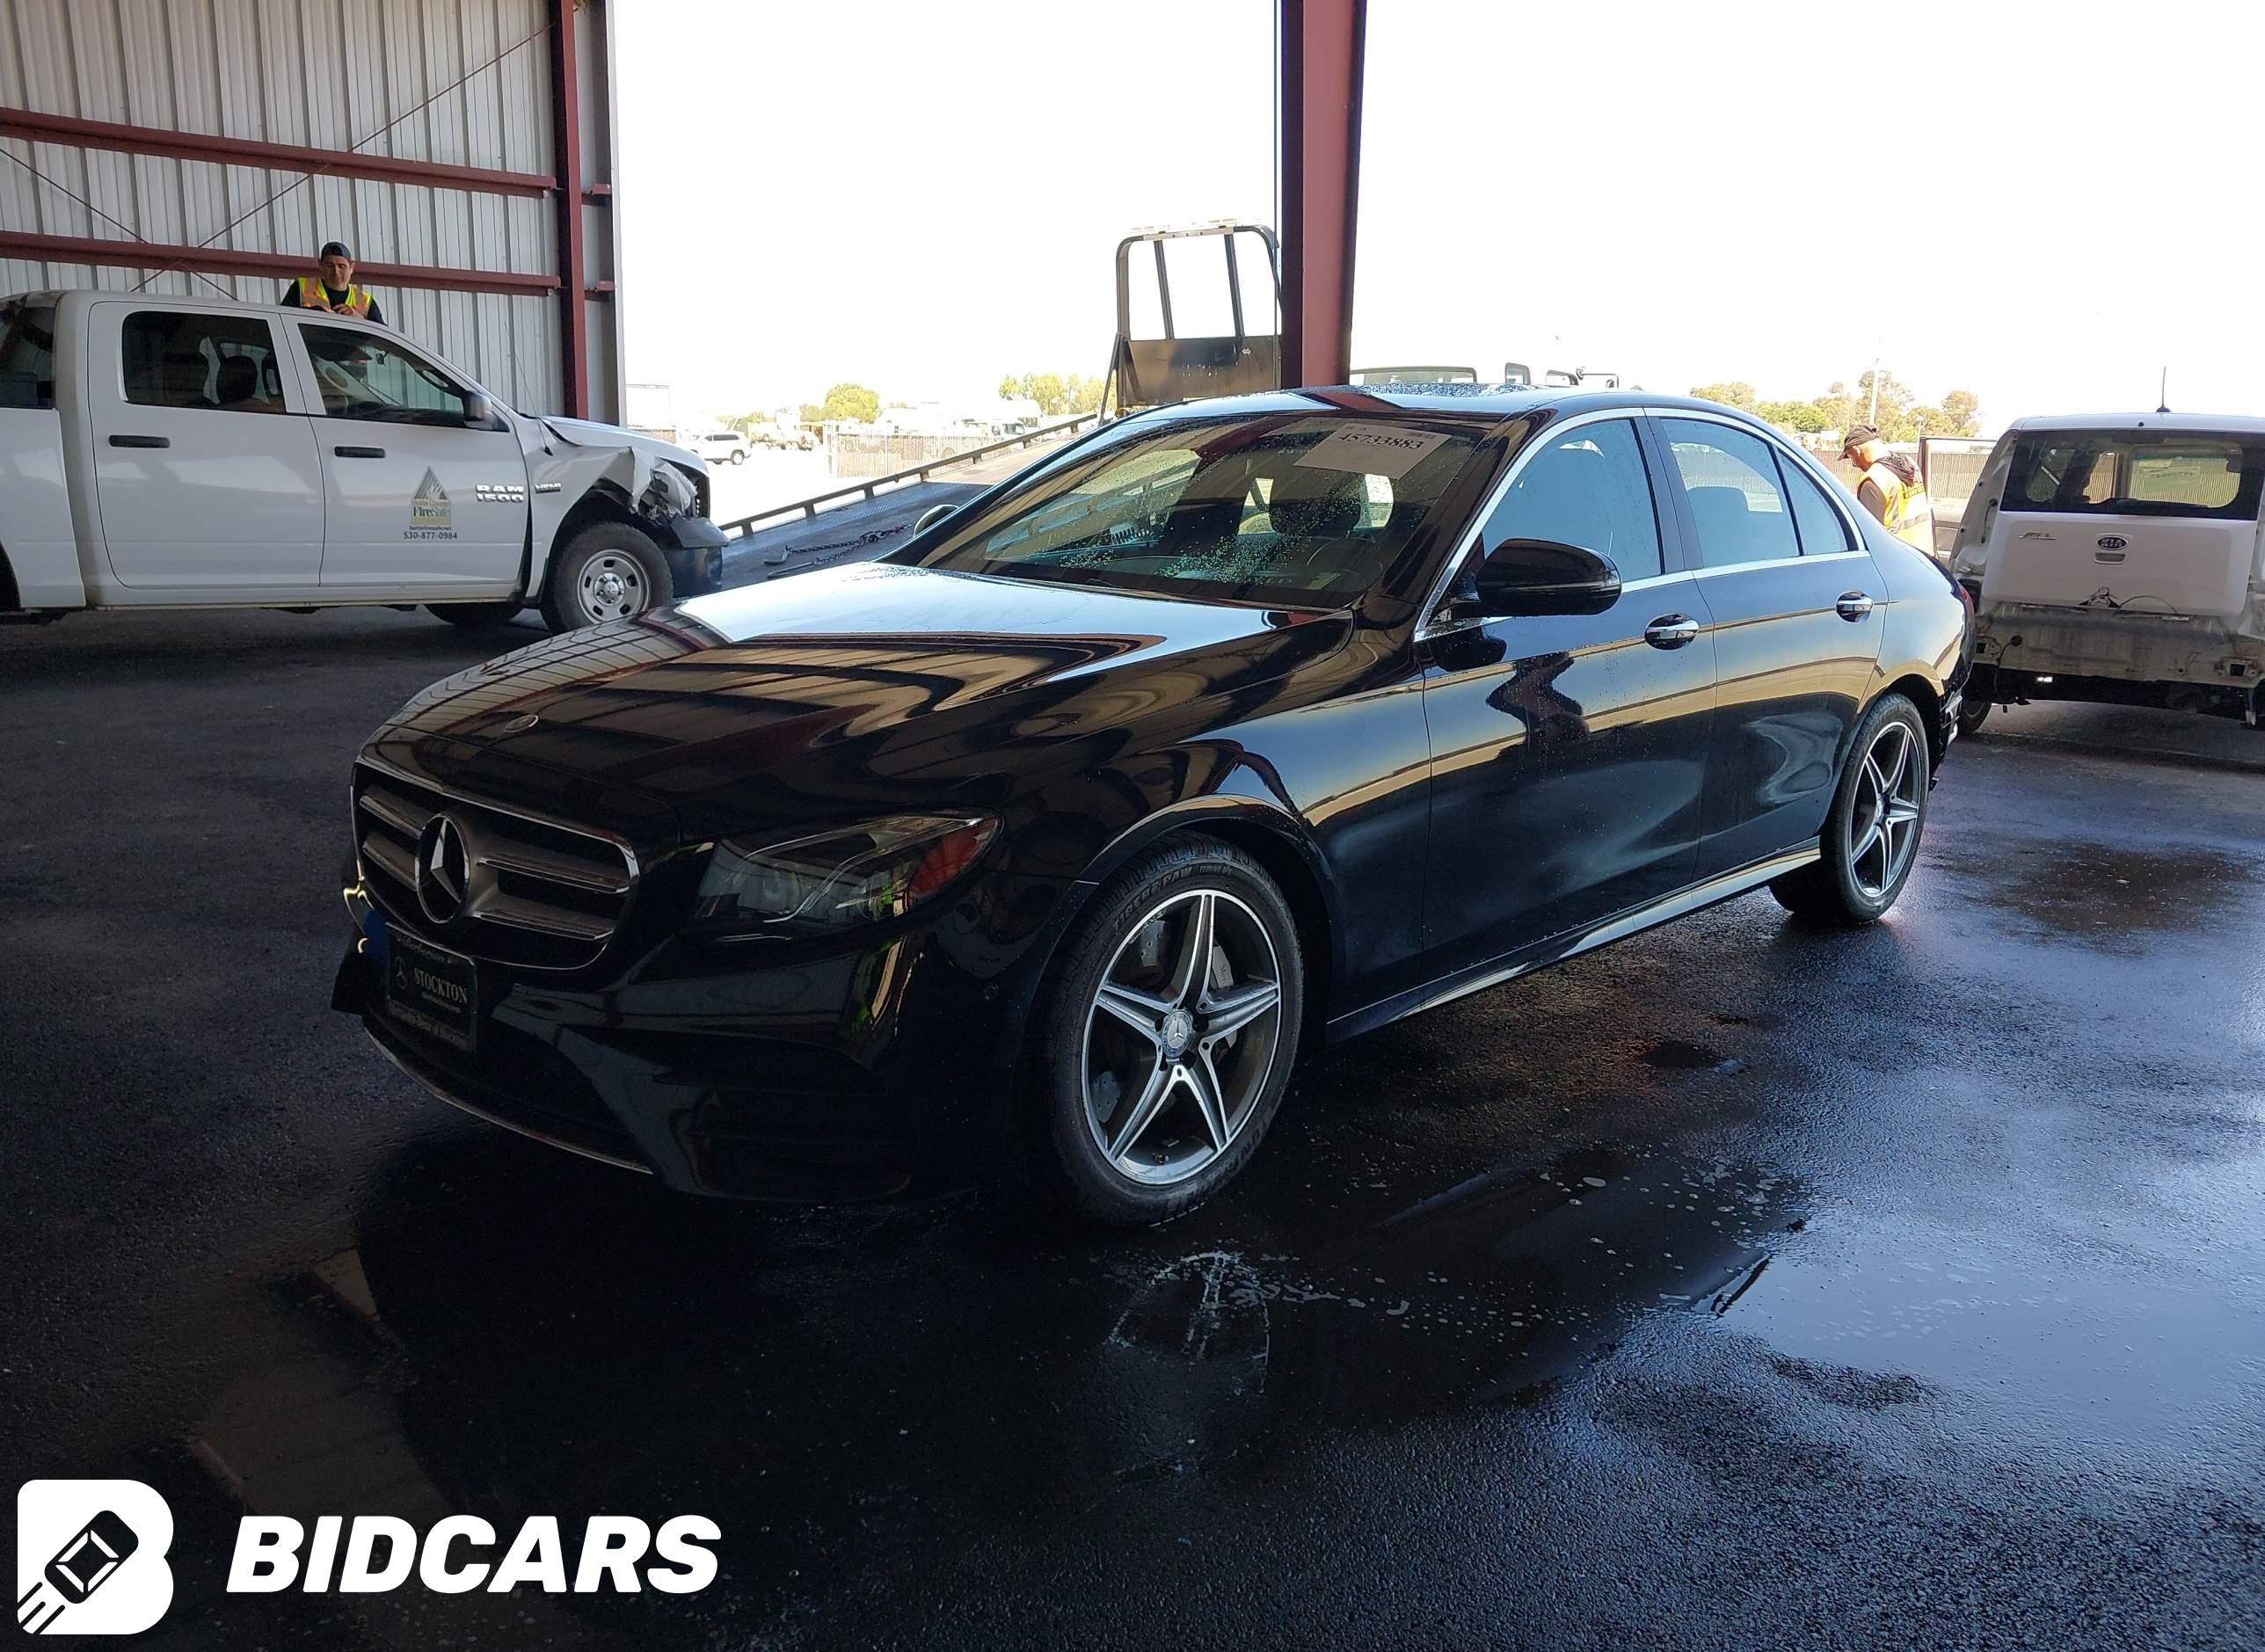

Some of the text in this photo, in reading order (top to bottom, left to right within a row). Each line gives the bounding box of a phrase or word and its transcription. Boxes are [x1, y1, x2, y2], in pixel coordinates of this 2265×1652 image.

[476, 484, 524, 493] RAM
[476, 493, 524, 503] 1500
[2100, 538, 2123, 549] KIA
[413, 967, 469, 1005] STOCKTON
